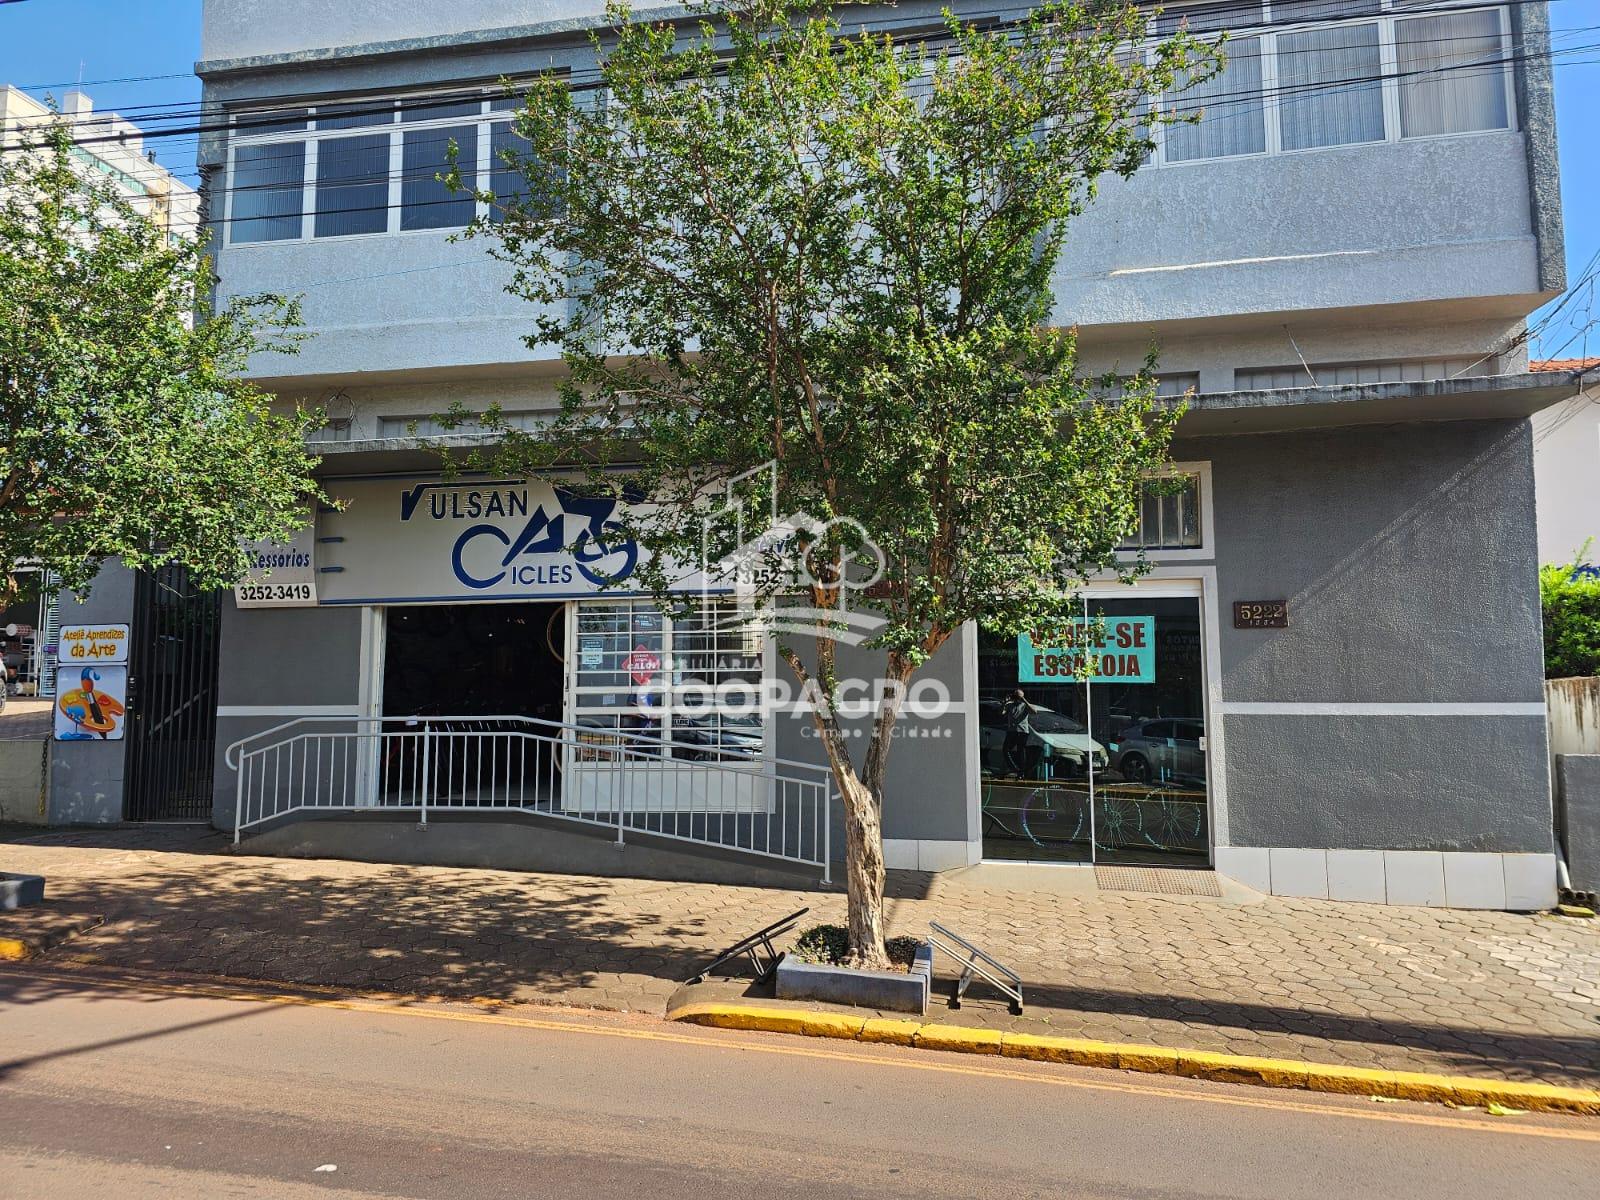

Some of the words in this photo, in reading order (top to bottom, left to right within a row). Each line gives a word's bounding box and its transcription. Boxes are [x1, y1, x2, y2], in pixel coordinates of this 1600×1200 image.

[401, 479, 527, 520] VULSAN
[240, 584, 310, 601] 3252-3419
[1241, 604, 1283, 620] 5222
[86, 629, 125, 641] Aprendizes
[1029, 623, 1146, 648] VNDE-SE
[71, 642, 85, 657] da
[87, 642, 116, 658] Arte
